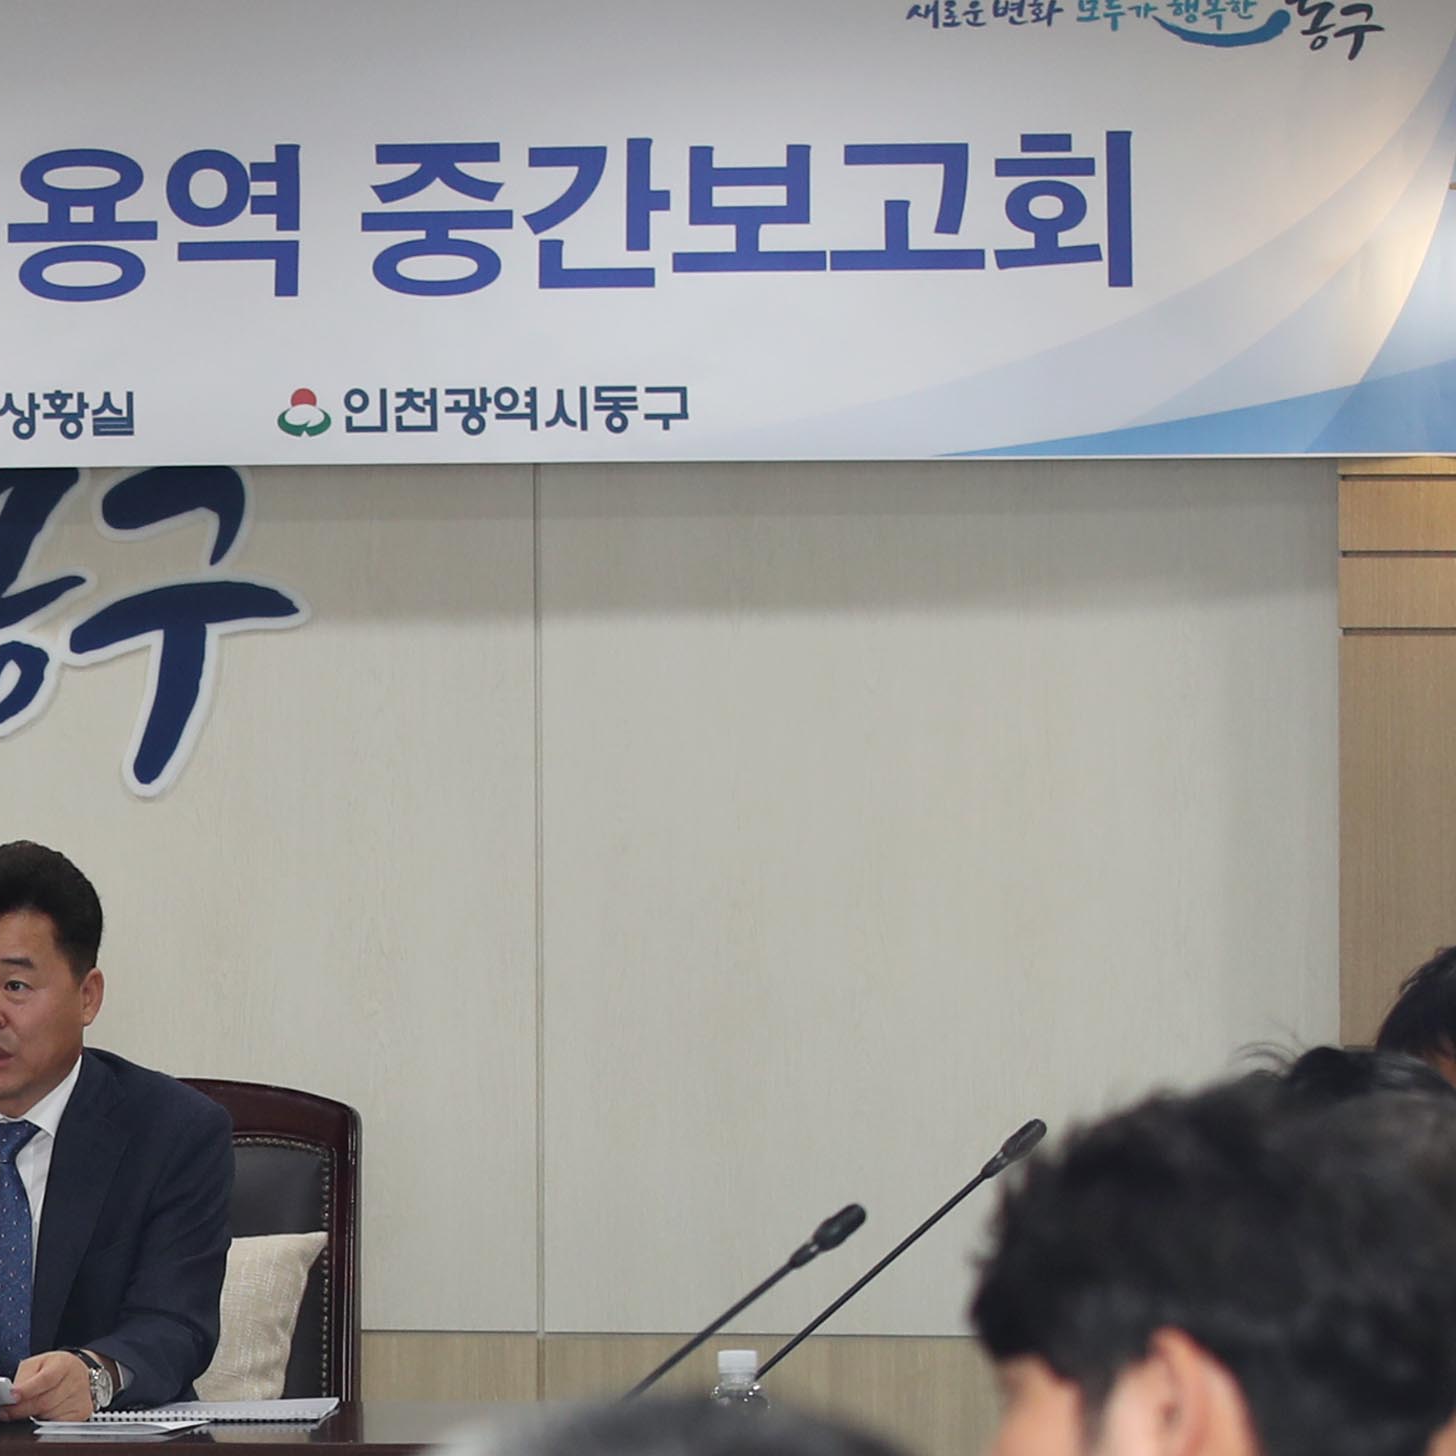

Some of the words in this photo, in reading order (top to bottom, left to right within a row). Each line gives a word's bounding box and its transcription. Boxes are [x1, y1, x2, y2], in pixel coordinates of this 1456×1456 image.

[1167, 0, 1257, 31] 행복한
[359, 129, 1134, 298] 중간보고회
[342, 384, 690, 437] 인천광역시동구
